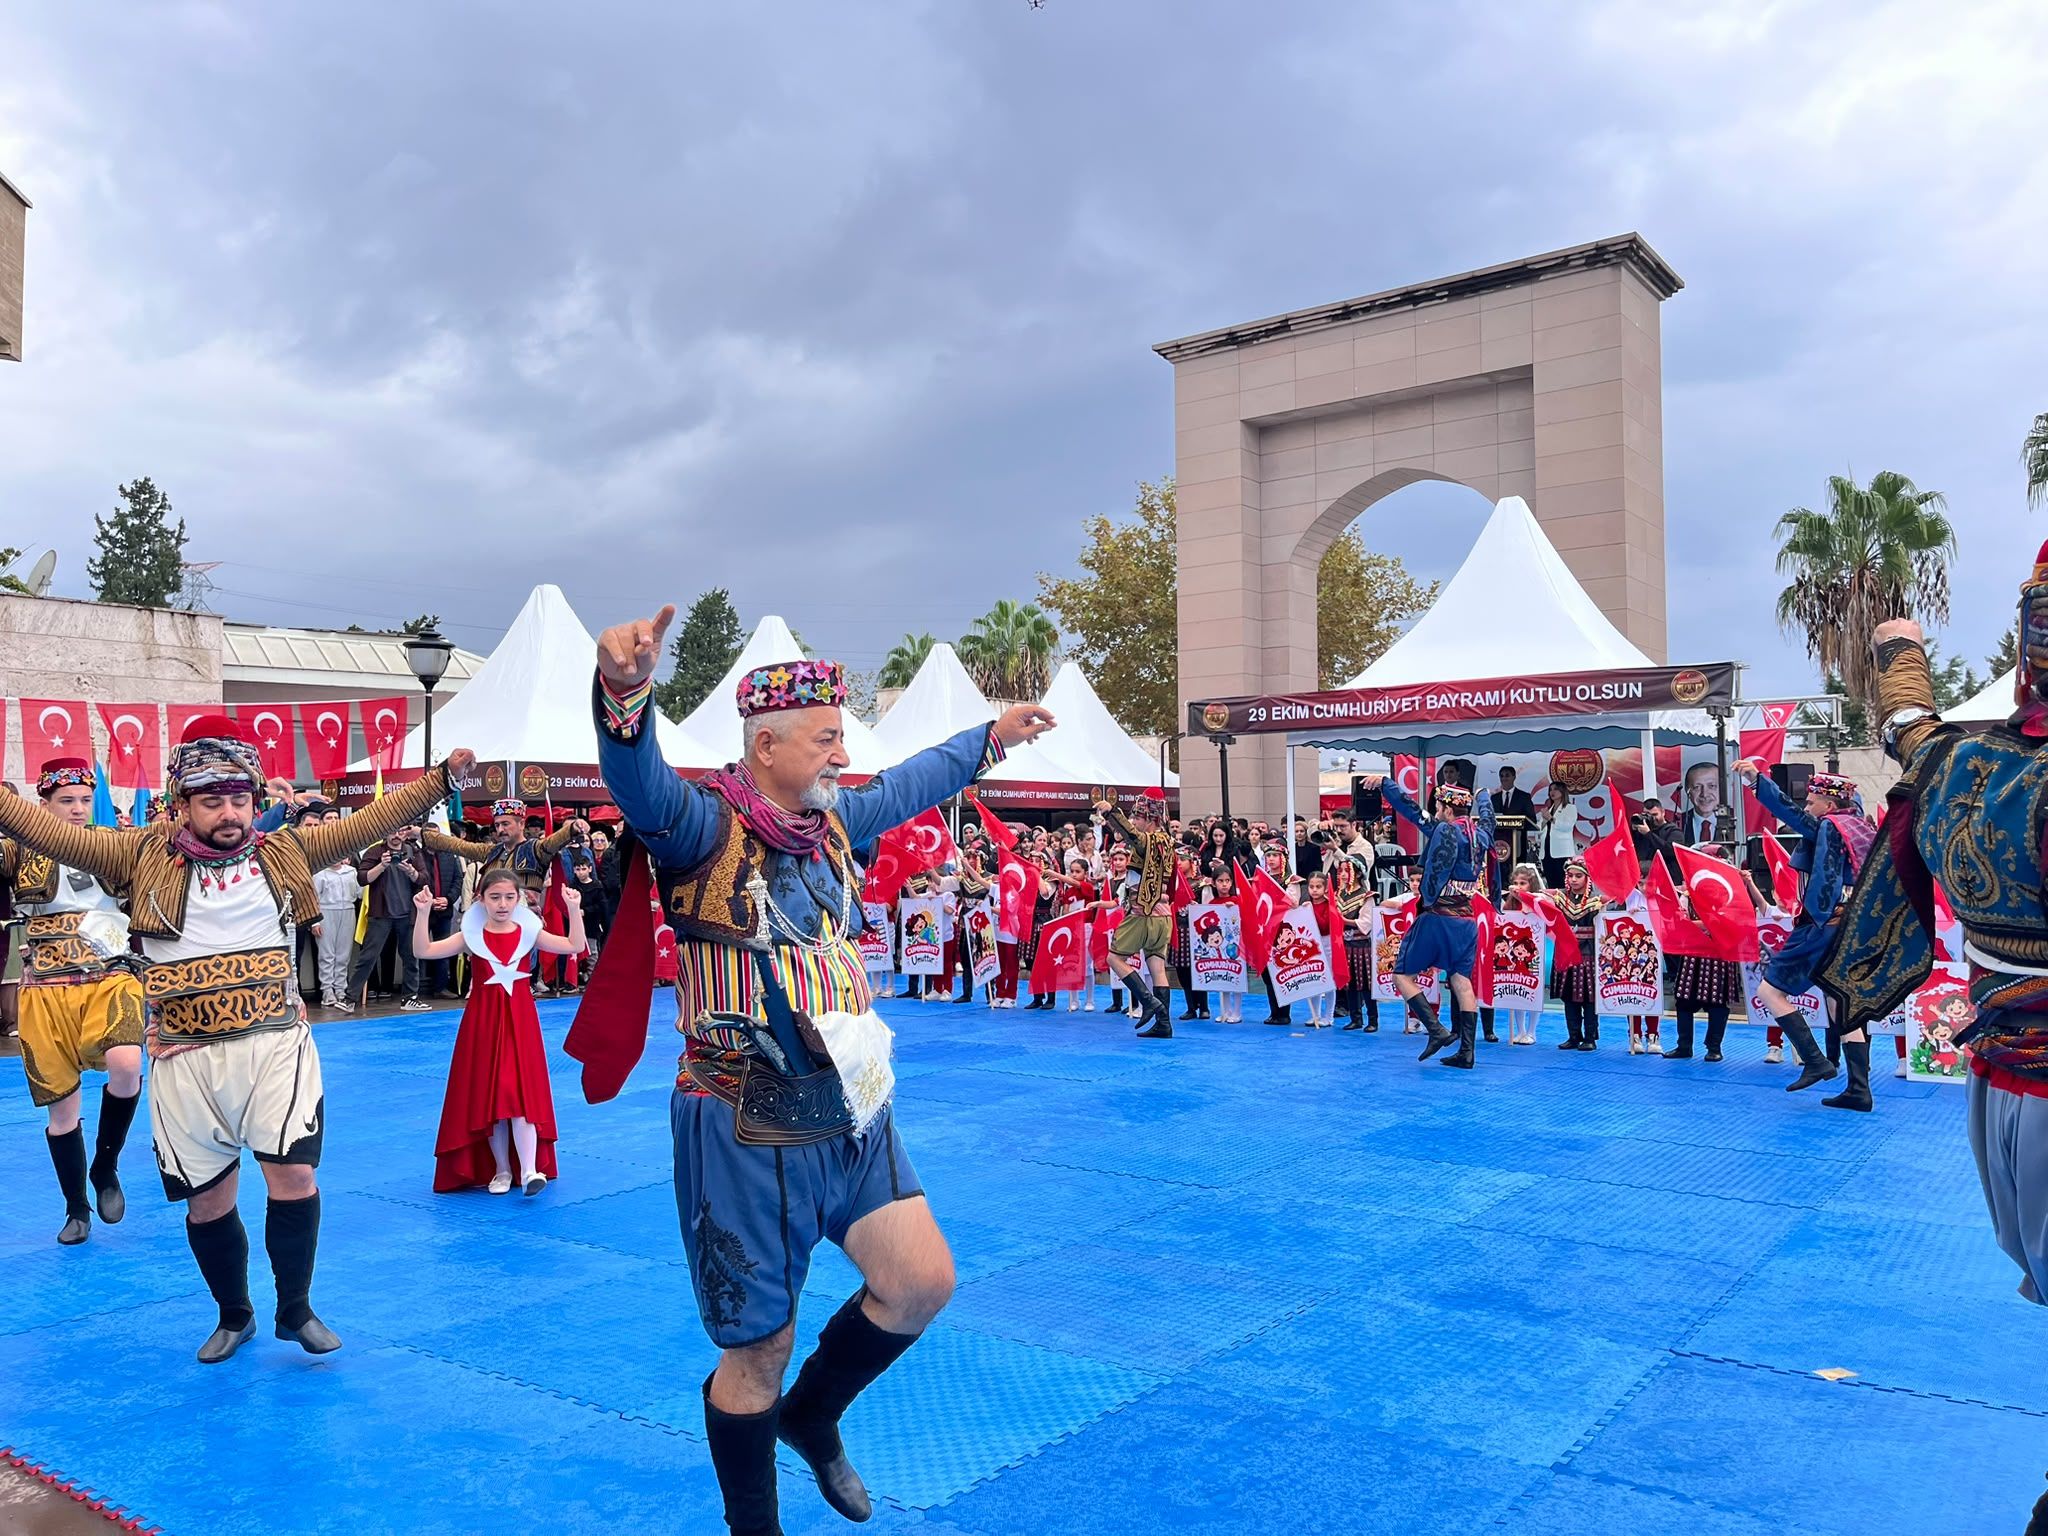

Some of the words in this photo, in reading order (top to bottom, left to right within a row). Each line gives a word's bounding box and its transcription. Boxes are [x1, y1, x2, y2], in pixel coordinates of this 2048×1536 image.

[1248, 707, 1267, 722] 29
[1271, 702, 1310, 720] EKİM
[1313, 696, 1422, 719] CUMHURİYET
[1426, 690, 1506, 710] BAYRAMI
[1509, 685, 1571, 704] KUTLU
[1575, 682, 1643, 701] OLSUN
[550, 777, 562, 788] 29
[565, 775, 588, 788] EKİM
[339, 786, 348, 796] 29
[348, 783, 363, 795] EKİM
[980, 789, 988, 798] 29
[988, 788, 1002, 798] EKİM
[1002, 789, 1036, 799] CUMHURİYET
[1036, 790, 1058, 800] BAYRAMI
[1073, 792, 1090, 801] OLSUN
[1197, 960, 1241, 973] CUMHURİYET
[1278, 962, 1323, 982] CUMHURİYET
[1602, 981, 1657, 998] CUMHURİYET
